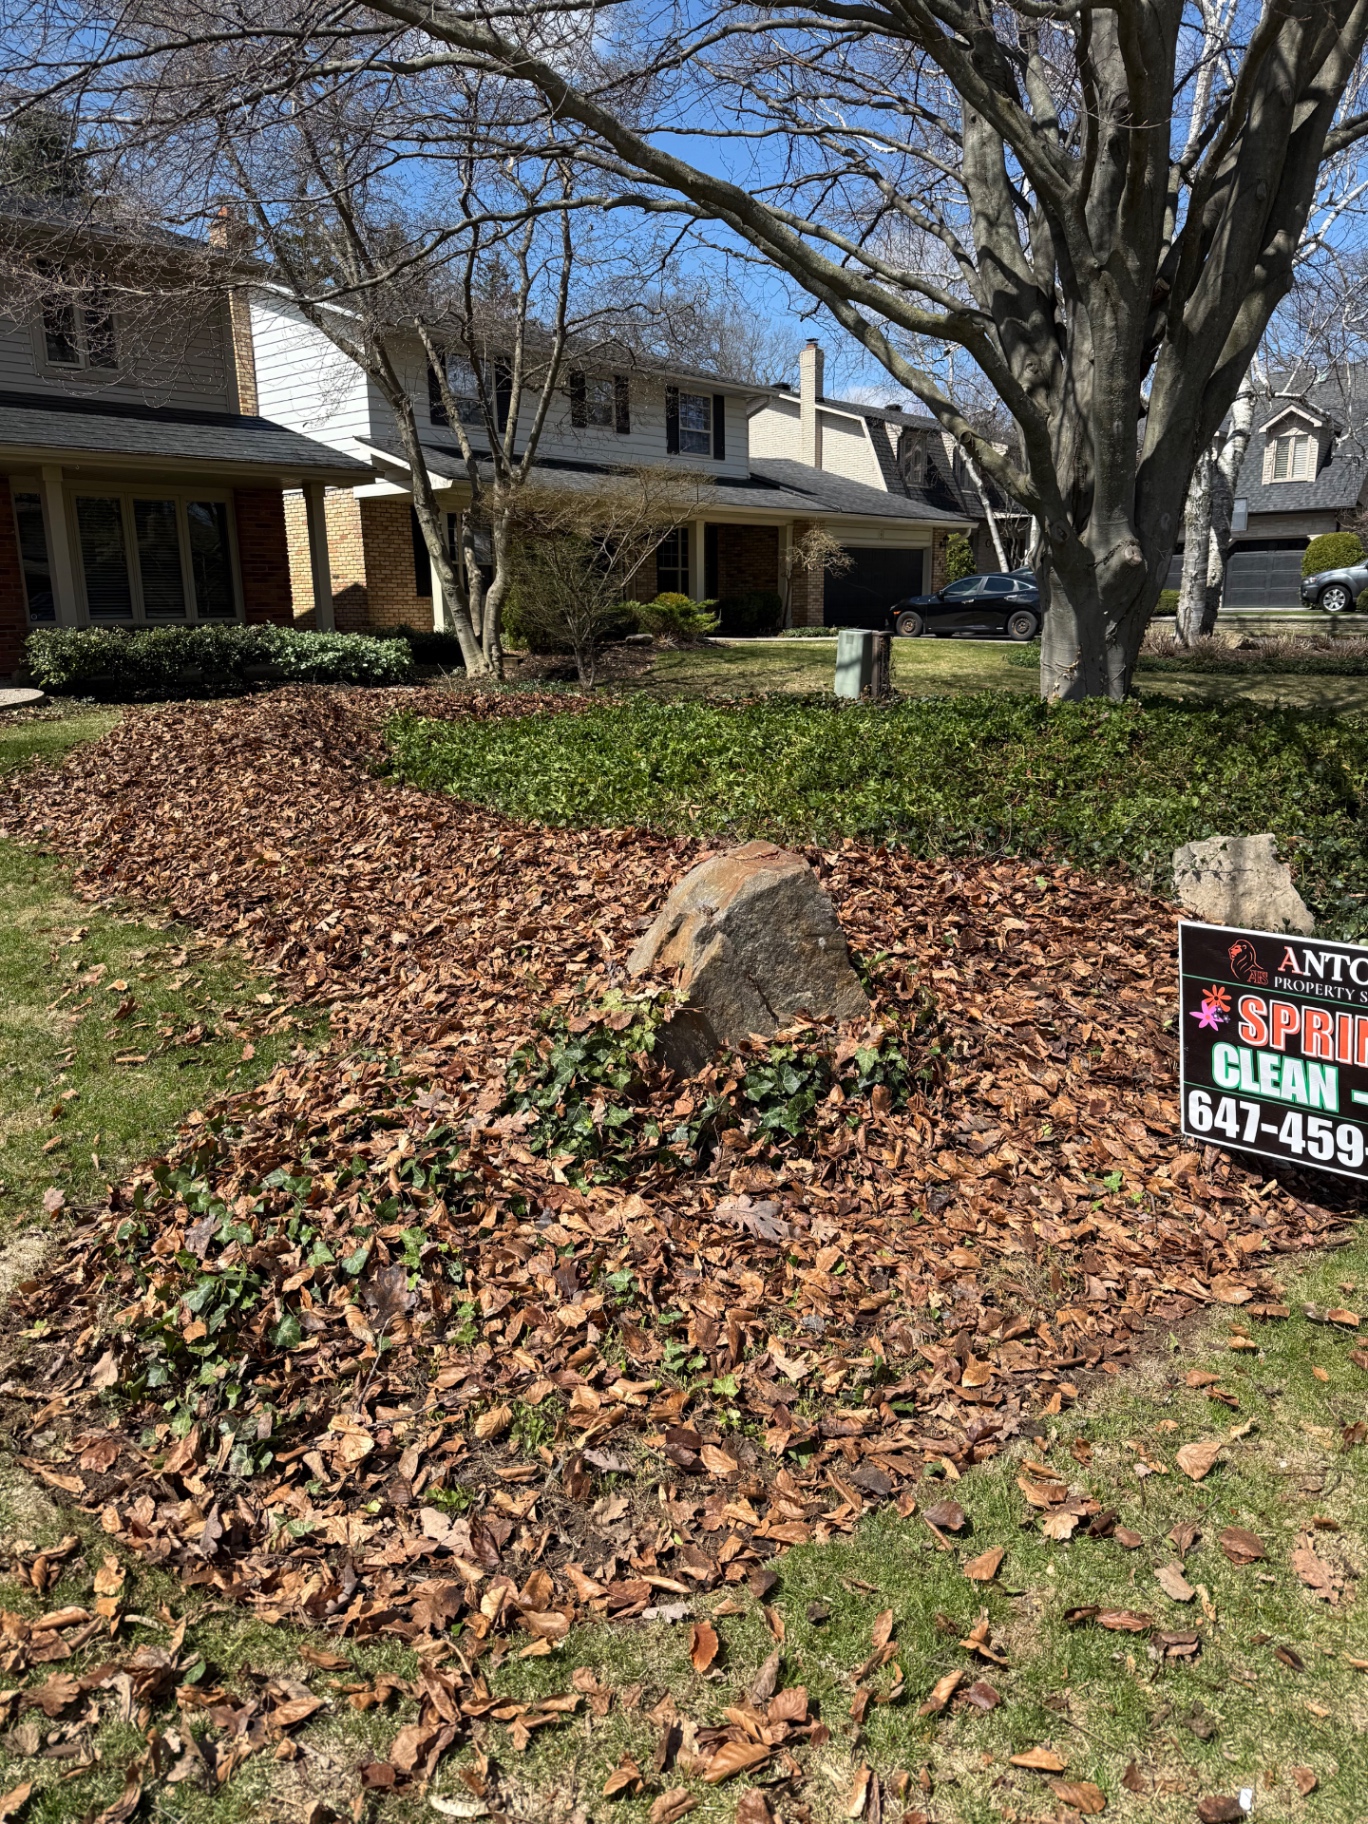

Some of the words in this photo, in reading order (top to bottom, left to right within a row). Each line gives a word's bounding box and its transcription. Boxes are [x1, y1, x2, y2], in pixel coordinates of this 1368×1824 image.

[1274, 976, 1356, 1001] PROPERTY
[1211, 1041, 1340, 1113] CLEAN
[1188, 1089, 1368, 1168] 647-459
